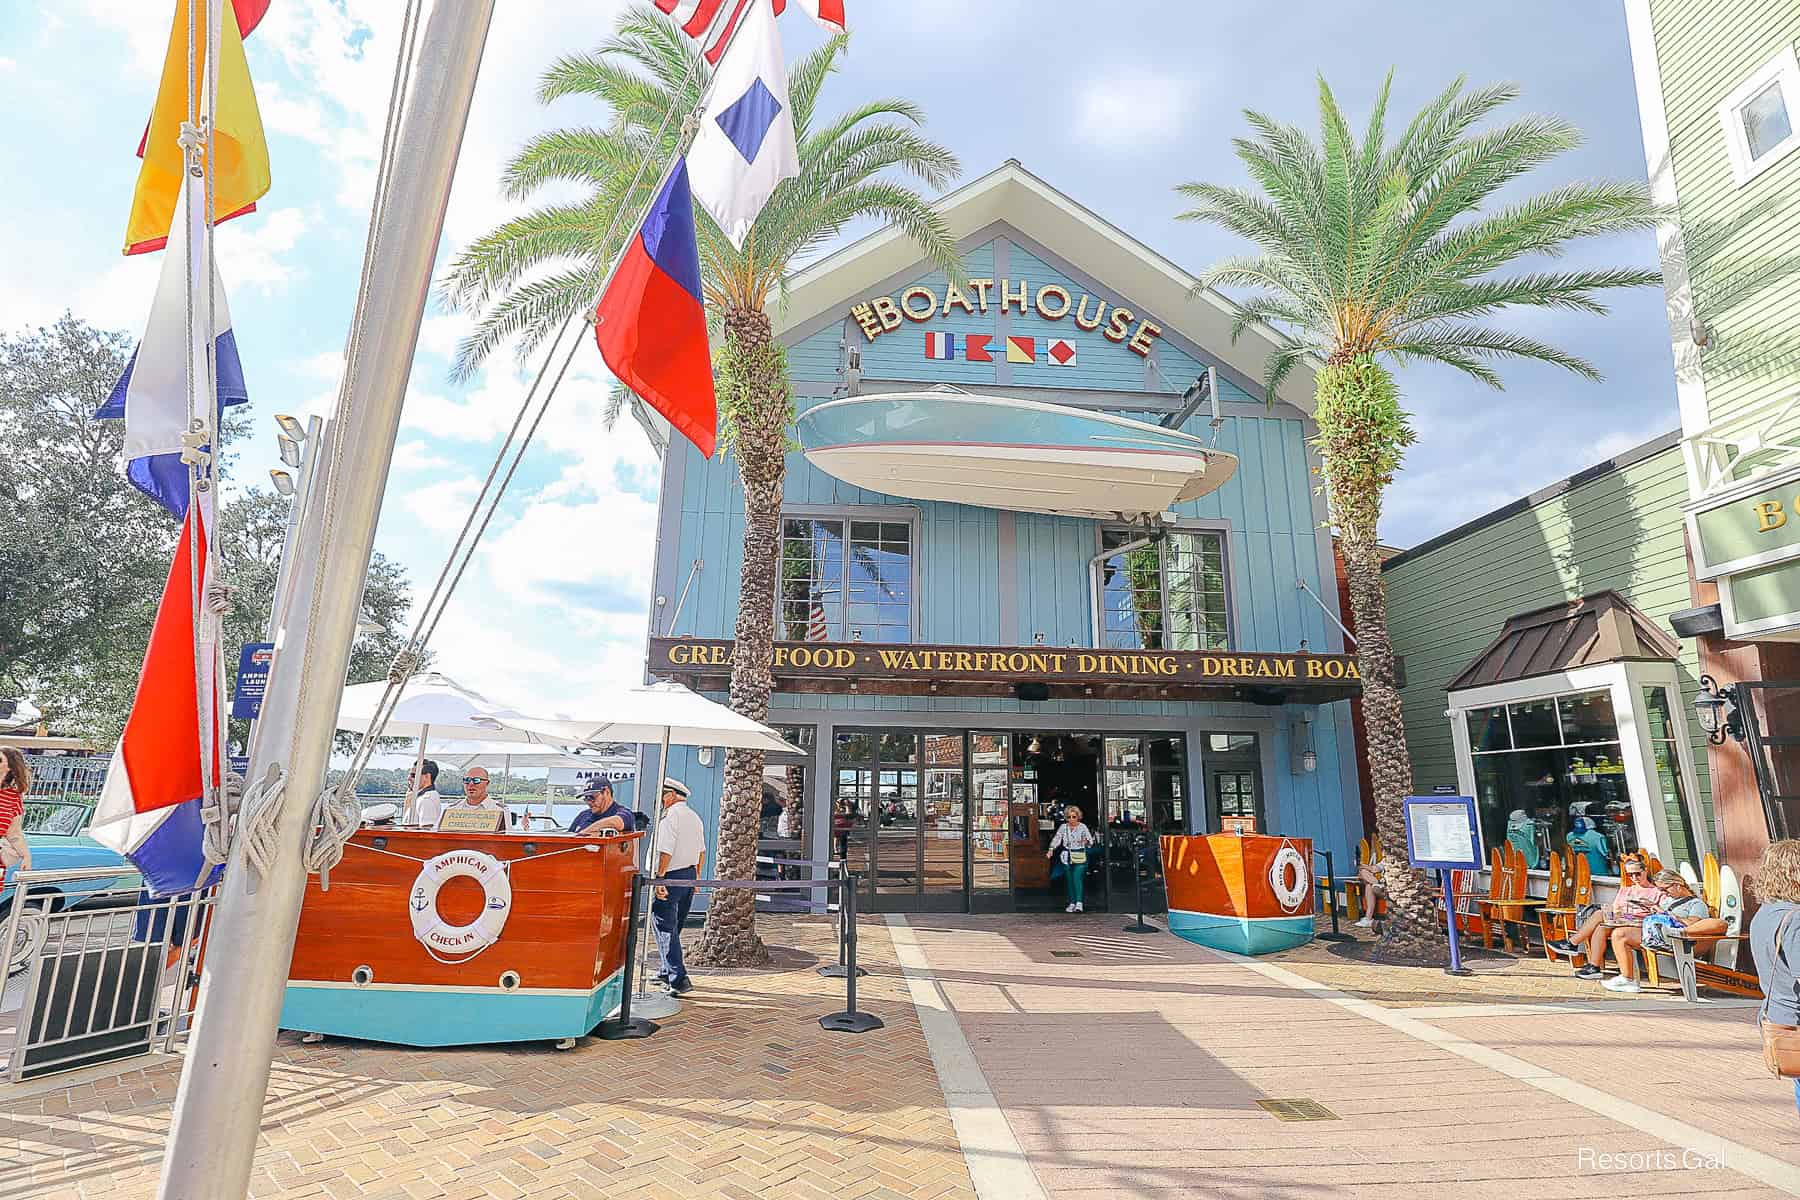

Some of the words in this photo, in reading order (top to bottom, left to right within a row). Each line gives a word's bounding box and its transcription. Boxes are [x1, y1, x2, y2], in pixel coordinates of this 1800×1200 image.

[851, 301, 883, 343] THE
[871, 278, 1162, 358] BOATHOUSE
[1753, 495, 1800, 533] B
[667, 643, 738, 667] GREA
[773, 647, 856, 669] FOOD
[879, 650, 1067, 673] WATERFRONT
[1077, 655, 1179, 676] DINING
[1202, 656, 1297, 679] DREAM
[1304, 659, 1361, 679] BOA
[434, 855, 488, 874] AMPHICAR
[430, 932, 462, 946] CHECK
[463, 931, 475, 943] IN
